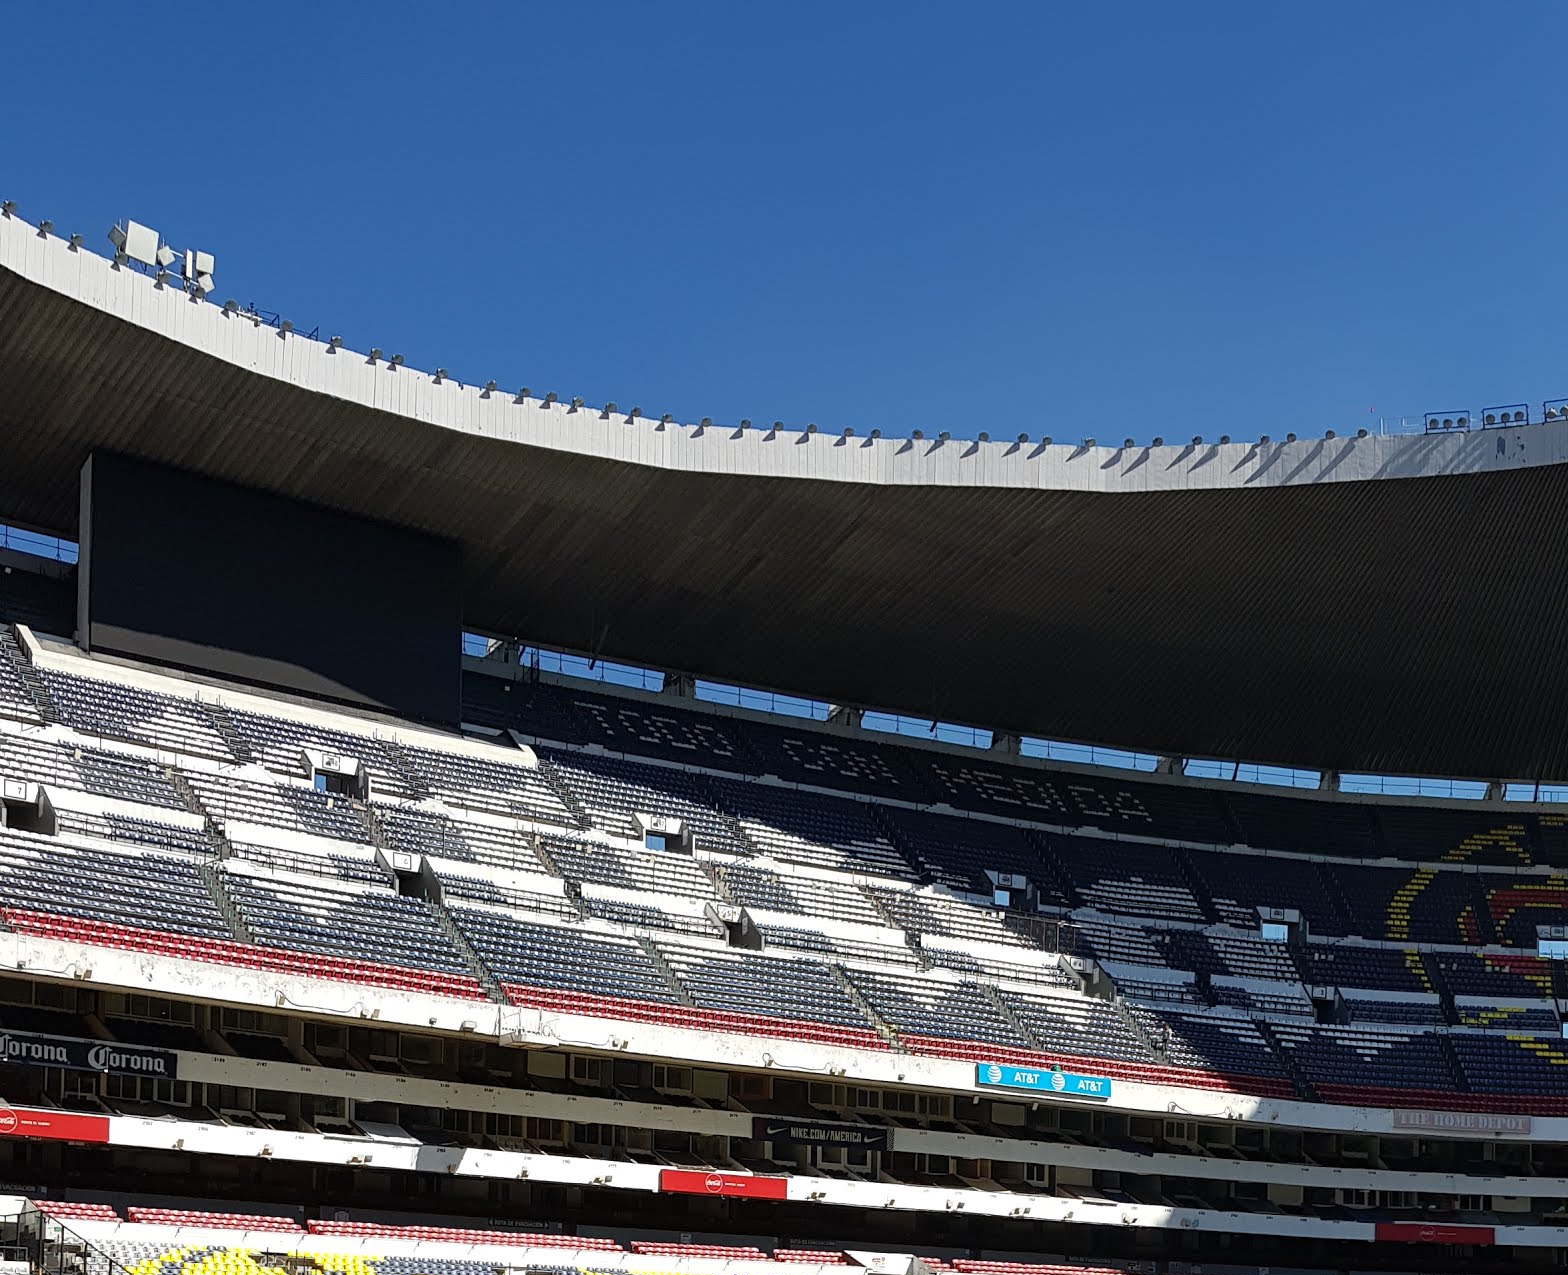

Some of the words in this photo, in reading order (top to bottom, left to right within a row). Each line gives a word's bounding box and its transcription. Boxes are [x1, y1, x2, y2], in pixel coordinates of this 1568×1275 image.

[88, 1045, 166, 1073] Corona
[1013, 1071, 1040, 1084] AT&T
[1078, 1080, 1103, 1093] AT&T
[790, 1126, 862, 1143] NIKE.COM/AMERICA
